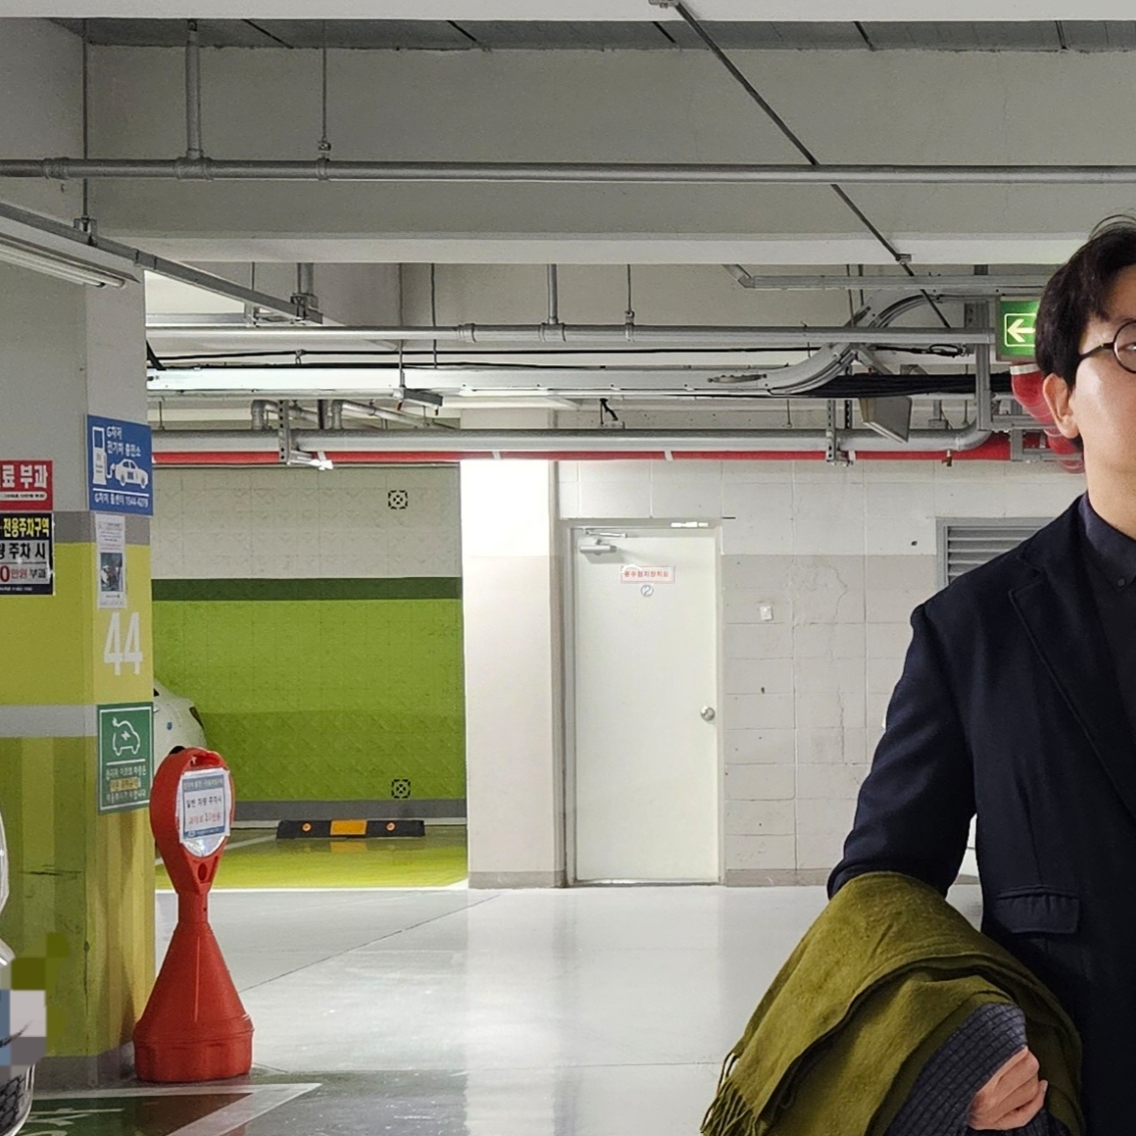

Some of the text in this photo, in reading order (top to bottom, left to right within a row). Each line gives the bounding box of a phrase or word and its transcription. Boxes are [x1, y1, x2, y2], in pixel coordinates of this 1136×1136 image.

[107, 440, 141, 457] 전기차 충전소
[20, 464, 48, 489] 부과
[3, 517, 49, 538] 전용주차구역
[9, 543, 31, 560] 주차
[34, 542, 46, 560] 시
[28, 568, 46, 579] 부과
[103, 611, 143, 676] 44
